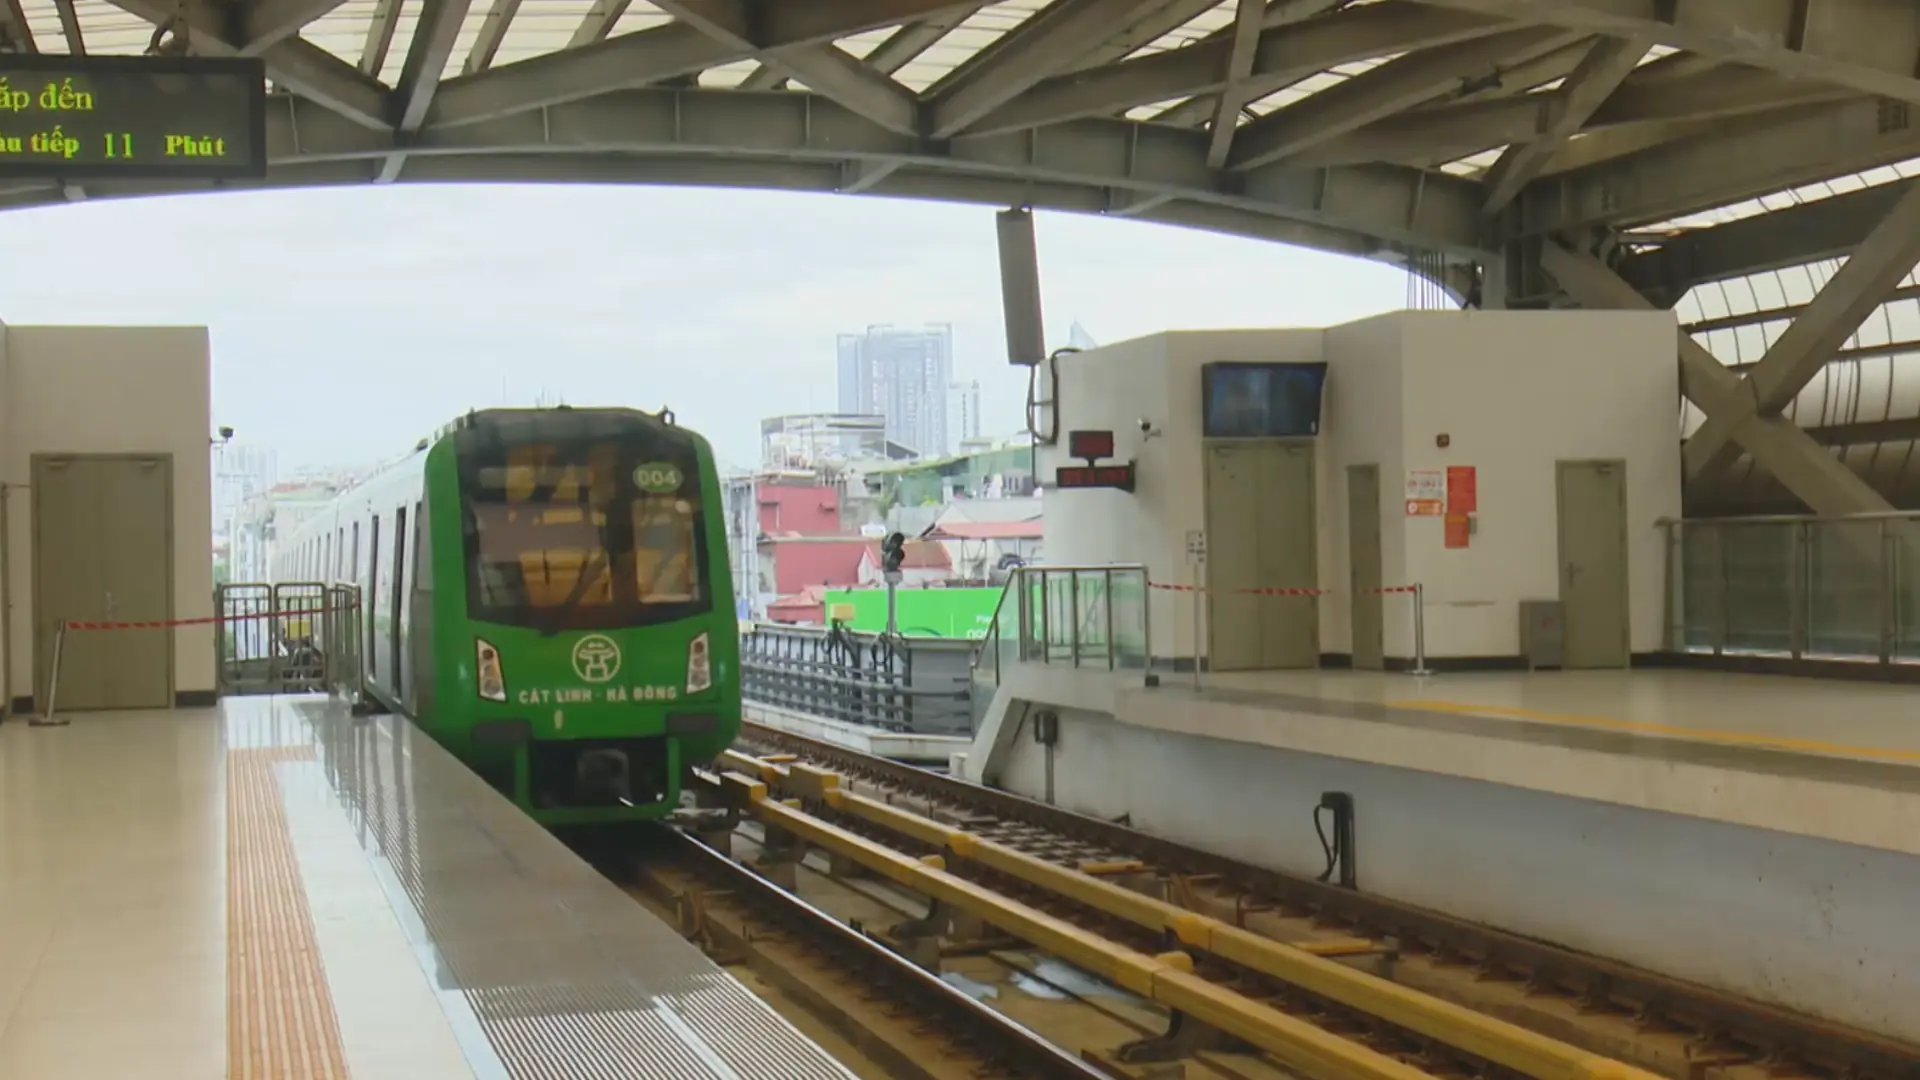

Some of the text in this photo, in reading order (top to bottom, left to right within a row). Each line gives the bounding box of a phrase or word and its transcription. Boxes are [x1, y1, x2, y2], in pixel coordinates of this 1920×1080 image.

[39, 78, 93, 110] đến
[31, 125, 80, 158] tiếp
[104, 133, 132, 158] 11
[164, 135, 226, 156] Phút
[636, 469, 676, 486] 004
[555, 688, 593, 703] LINH
